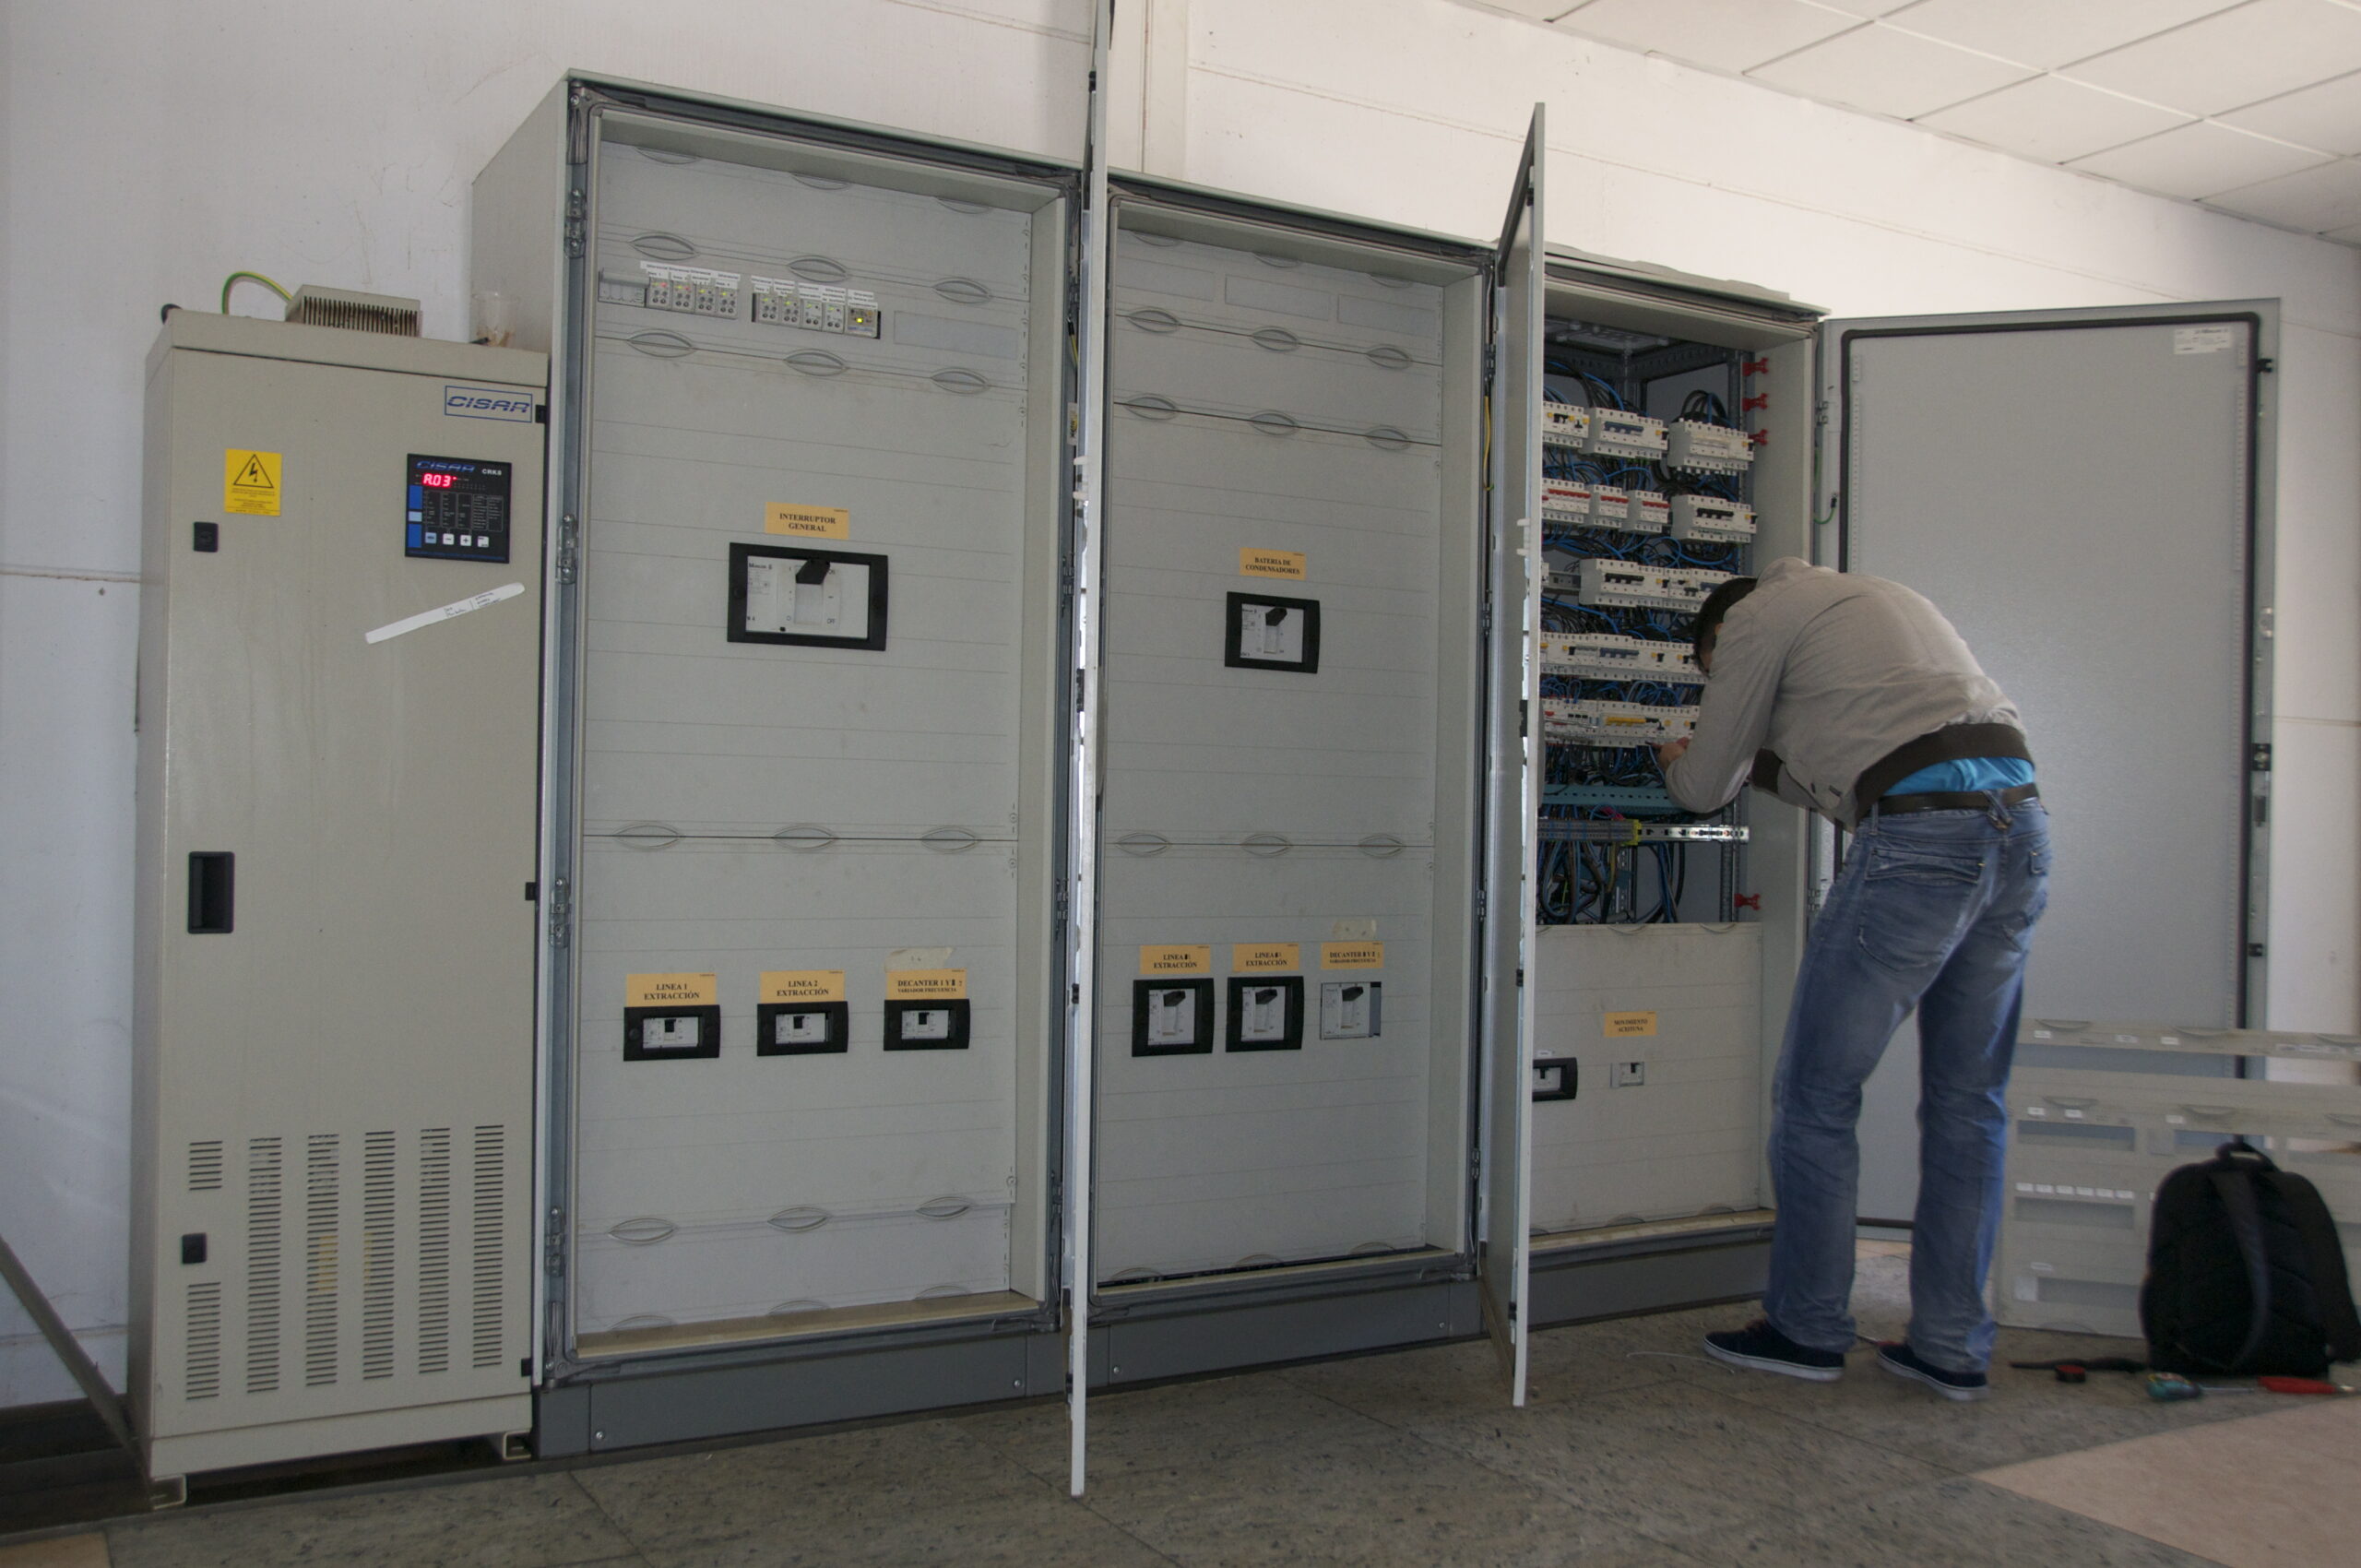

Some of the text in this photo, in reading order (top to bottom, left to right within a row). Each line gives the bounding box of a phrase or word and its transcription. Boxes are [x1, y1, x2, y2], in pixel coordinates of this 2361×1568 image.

[447, 396, 529, 413] CISAR
[779, 513, 836, 524] INTERRUPTOR
[789, 523, 826, 532] GENERAL
[1245, 564, 1300, 574] CONDENSADORES
[644, 991, 700, 1001] EXTRACCIÓN
[777, 987, 829, 996] EXTRACCIÓN
